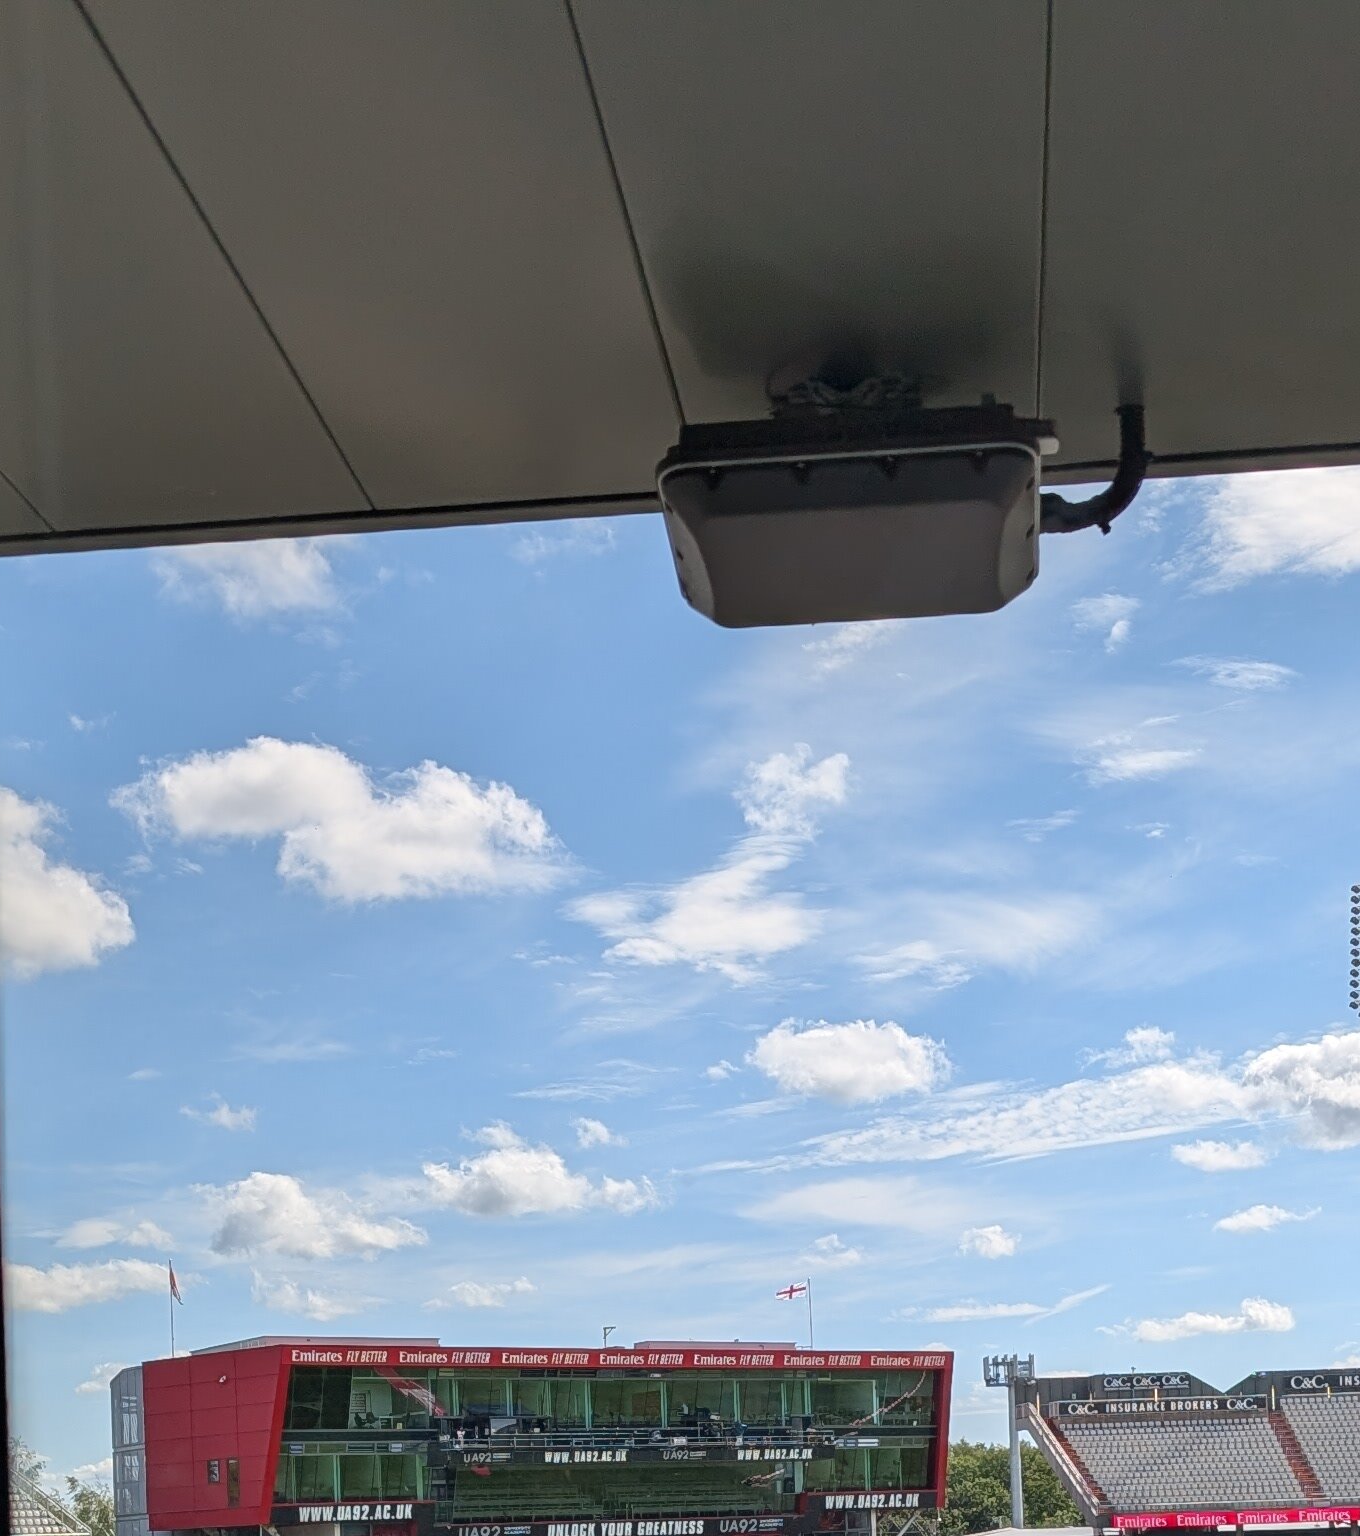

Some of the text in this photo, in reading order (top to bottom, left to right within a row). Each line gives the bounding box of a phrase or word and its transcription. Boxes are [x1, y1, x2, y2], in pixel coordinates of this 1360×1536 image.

[291, 1350, 387, 1363] Emirates FLY BETTER
[399, 1350, 490, 1364] Emirates FLY BETTER
[502, 1351, 589, 1365] Emirates FLY BETTER
[599, 1353, 684, 1366] Emirates FLY BETTER
[694, 1354, 774, 1366] Emirates FLY BETTER
[783, 1354, 861, 1367] Emirates FLY BETTER
[870, 1354, 945, 1367] Emirates FLY BETTER
[1106, 1401, 1165, 1413] INSURANCE
[1170, 1400, 1219, 1411] BROKERS
[463, 1452, 492, 1463] UA92
[299, 1504, 413, 1522] WWW.UA92.AC.UK
[1176, 1513, 1227, 1526] Emirates
[1236, 1512, 1289, 1525] Emirates
[1298, 1509, 1351, 1523] Emirates
[601, 1521, 632, 1536] YOUR
[638, 1519, 704, 1536] GREATNESS
[720, 1519, 758, 1533] UA92
[1116, 1515, 1167, 1528] Emirates
